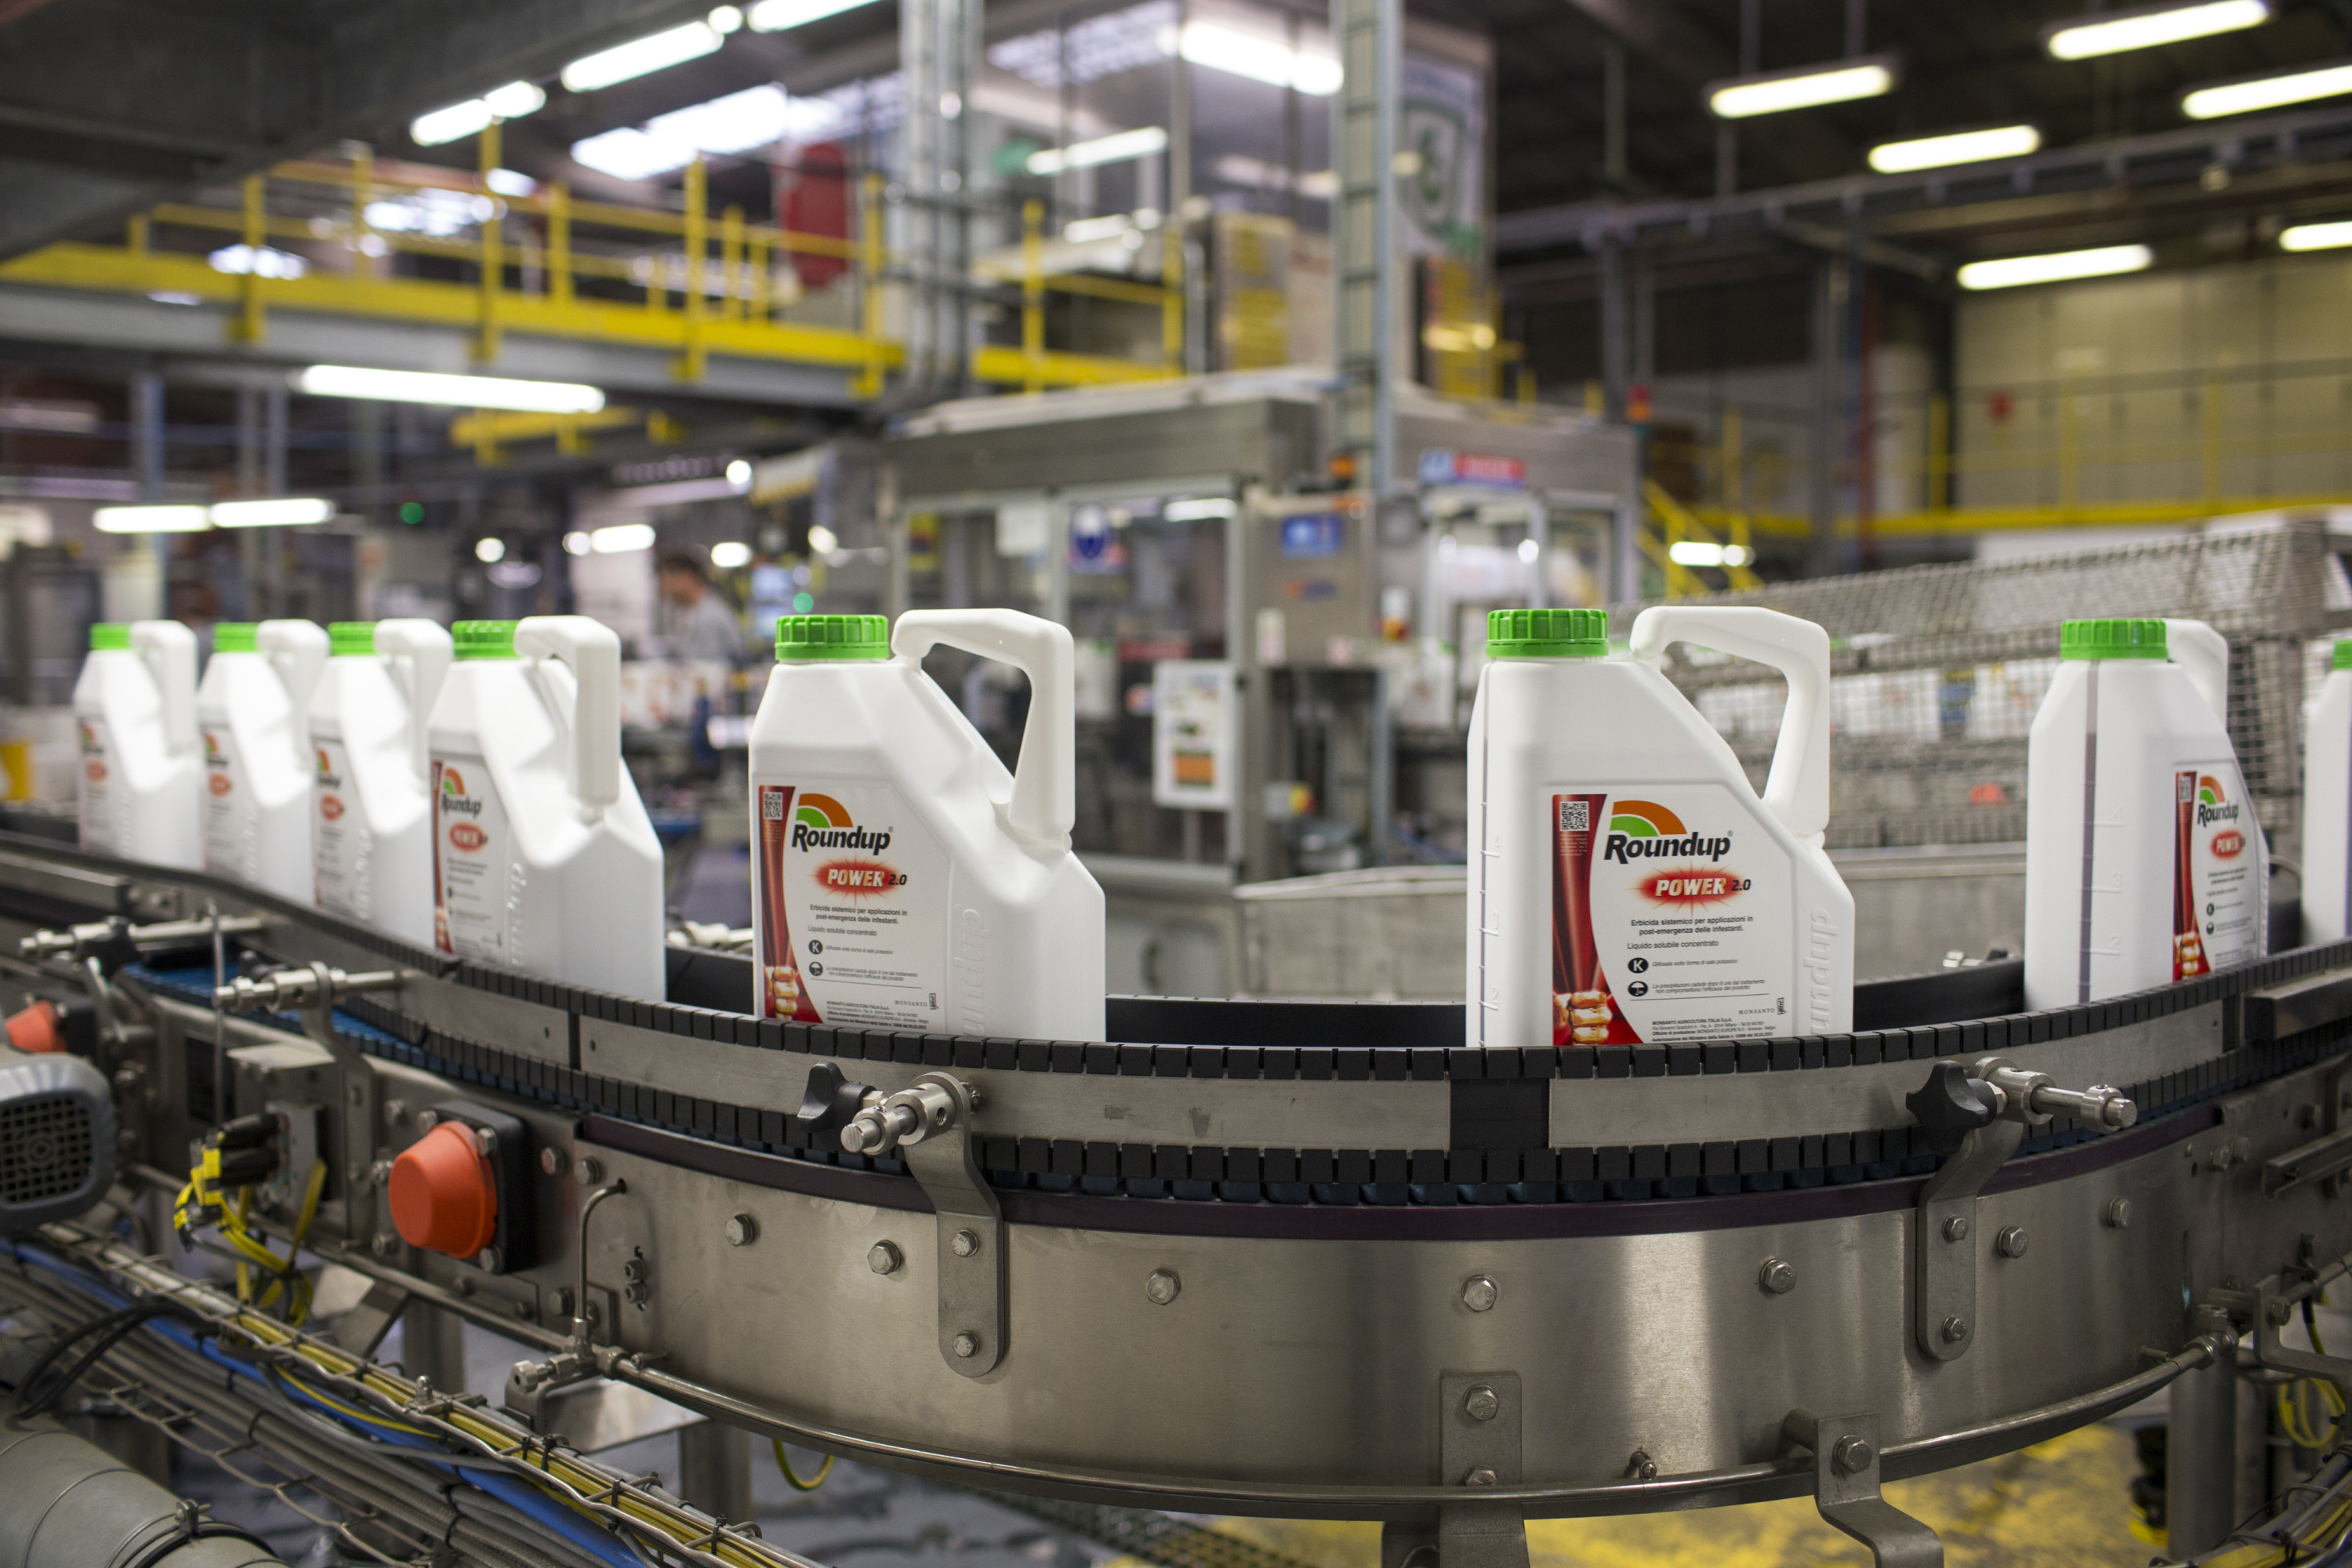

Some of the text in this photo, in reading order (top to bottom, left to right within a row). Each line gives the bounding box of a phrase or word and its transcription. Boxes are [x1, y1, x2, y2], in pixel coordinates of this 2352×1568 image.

[2198, 801, 2240, 827] Roundup
[826, 869, 908, 887] POWER 2.0
[1654, 877, 1751, 898] POWER 2.0
[1707, 916, 1746, 924] applicazioni
[1639, 927, 1693, 937] post-emergenza
[1803, 908, 1838, 1036] undup
